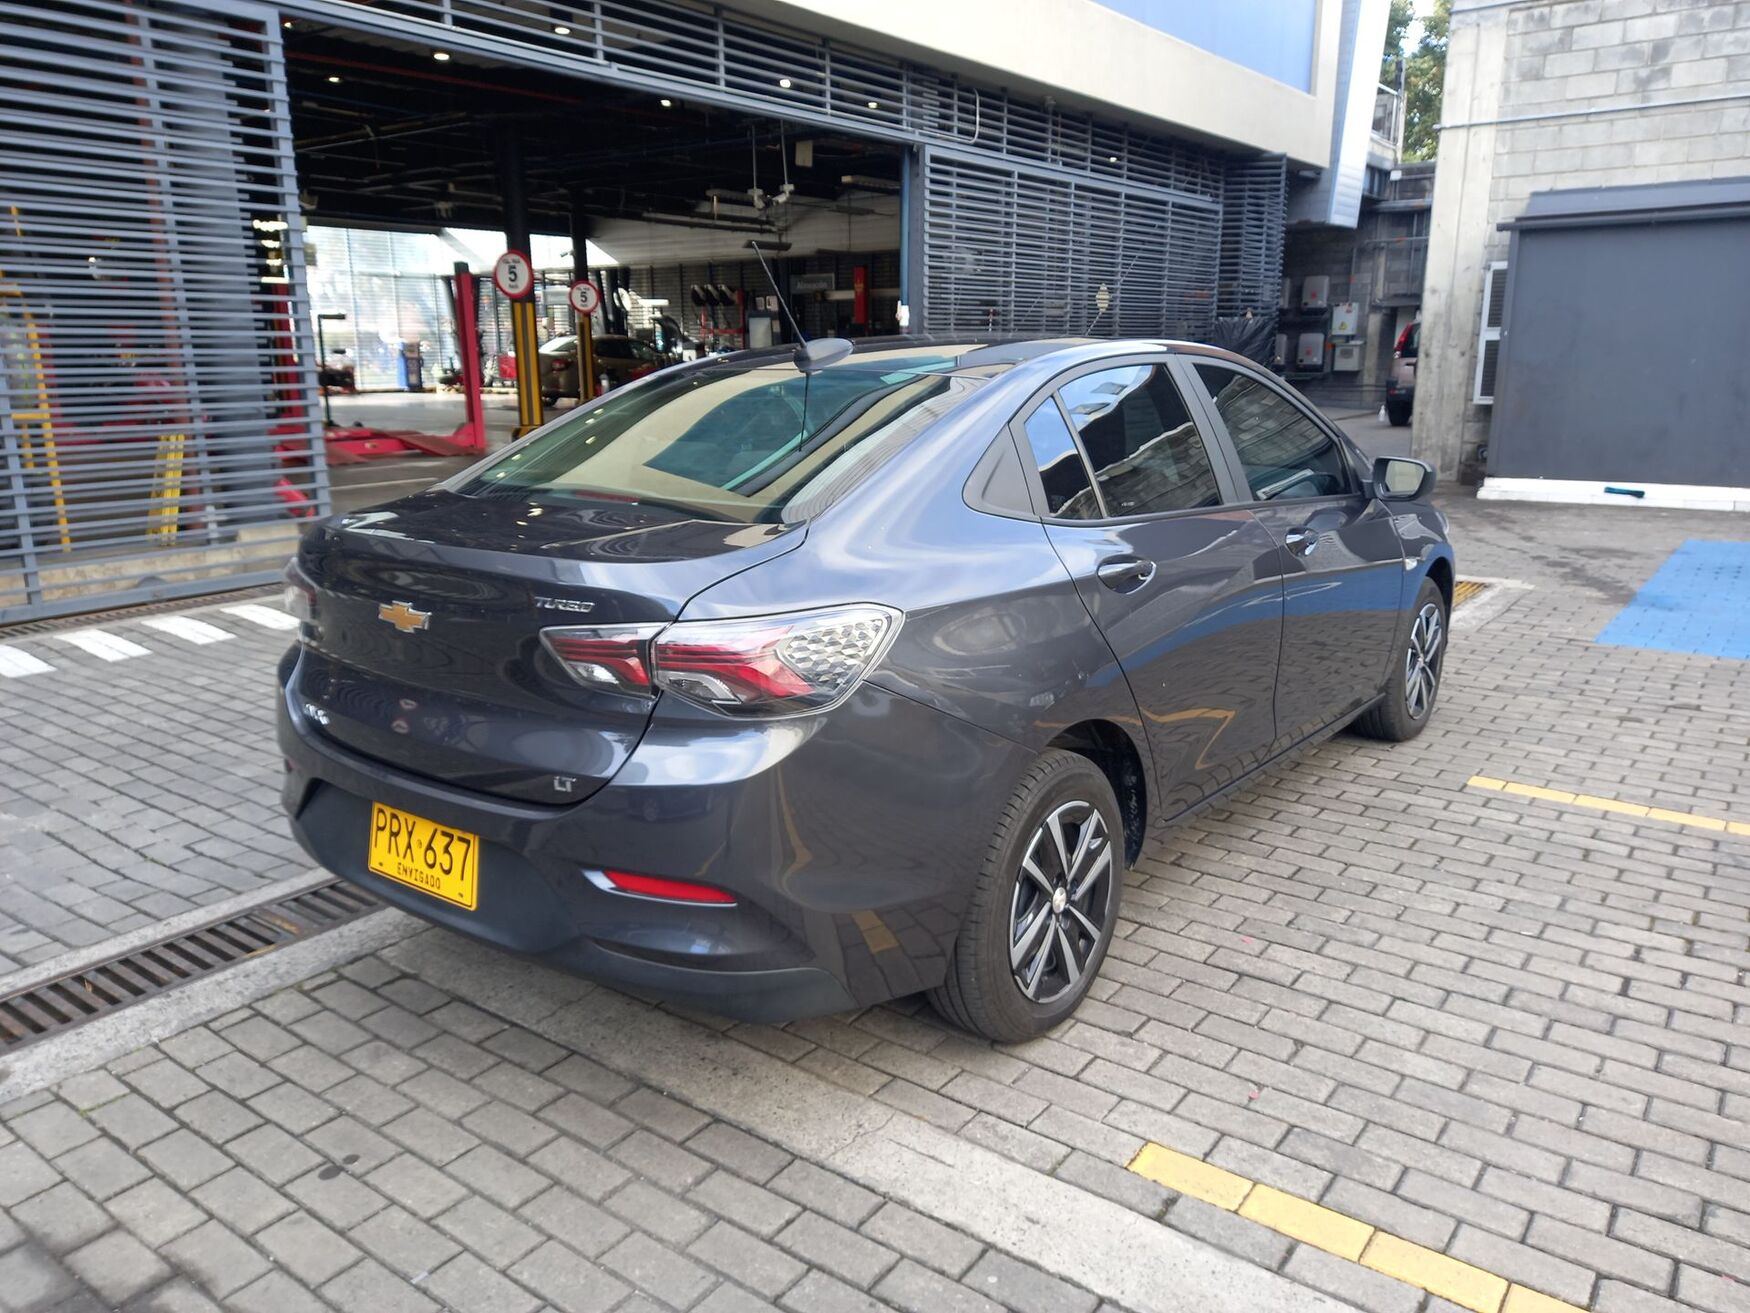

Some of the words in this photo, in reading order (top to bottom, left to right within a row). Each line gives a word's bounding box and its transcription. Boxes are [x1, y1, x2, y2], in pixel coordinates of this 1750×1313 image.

[508, 264, 518, 282] 5
[580, 291, 588, 303] 5
[534, 596, 595, 613] TURBO
[553, 776, 577, 792] LT
[374, 807, 416, 863] PRX
[424, 828, 471, 881] 637
[396, 862, 441, 889] ENVIGADO
